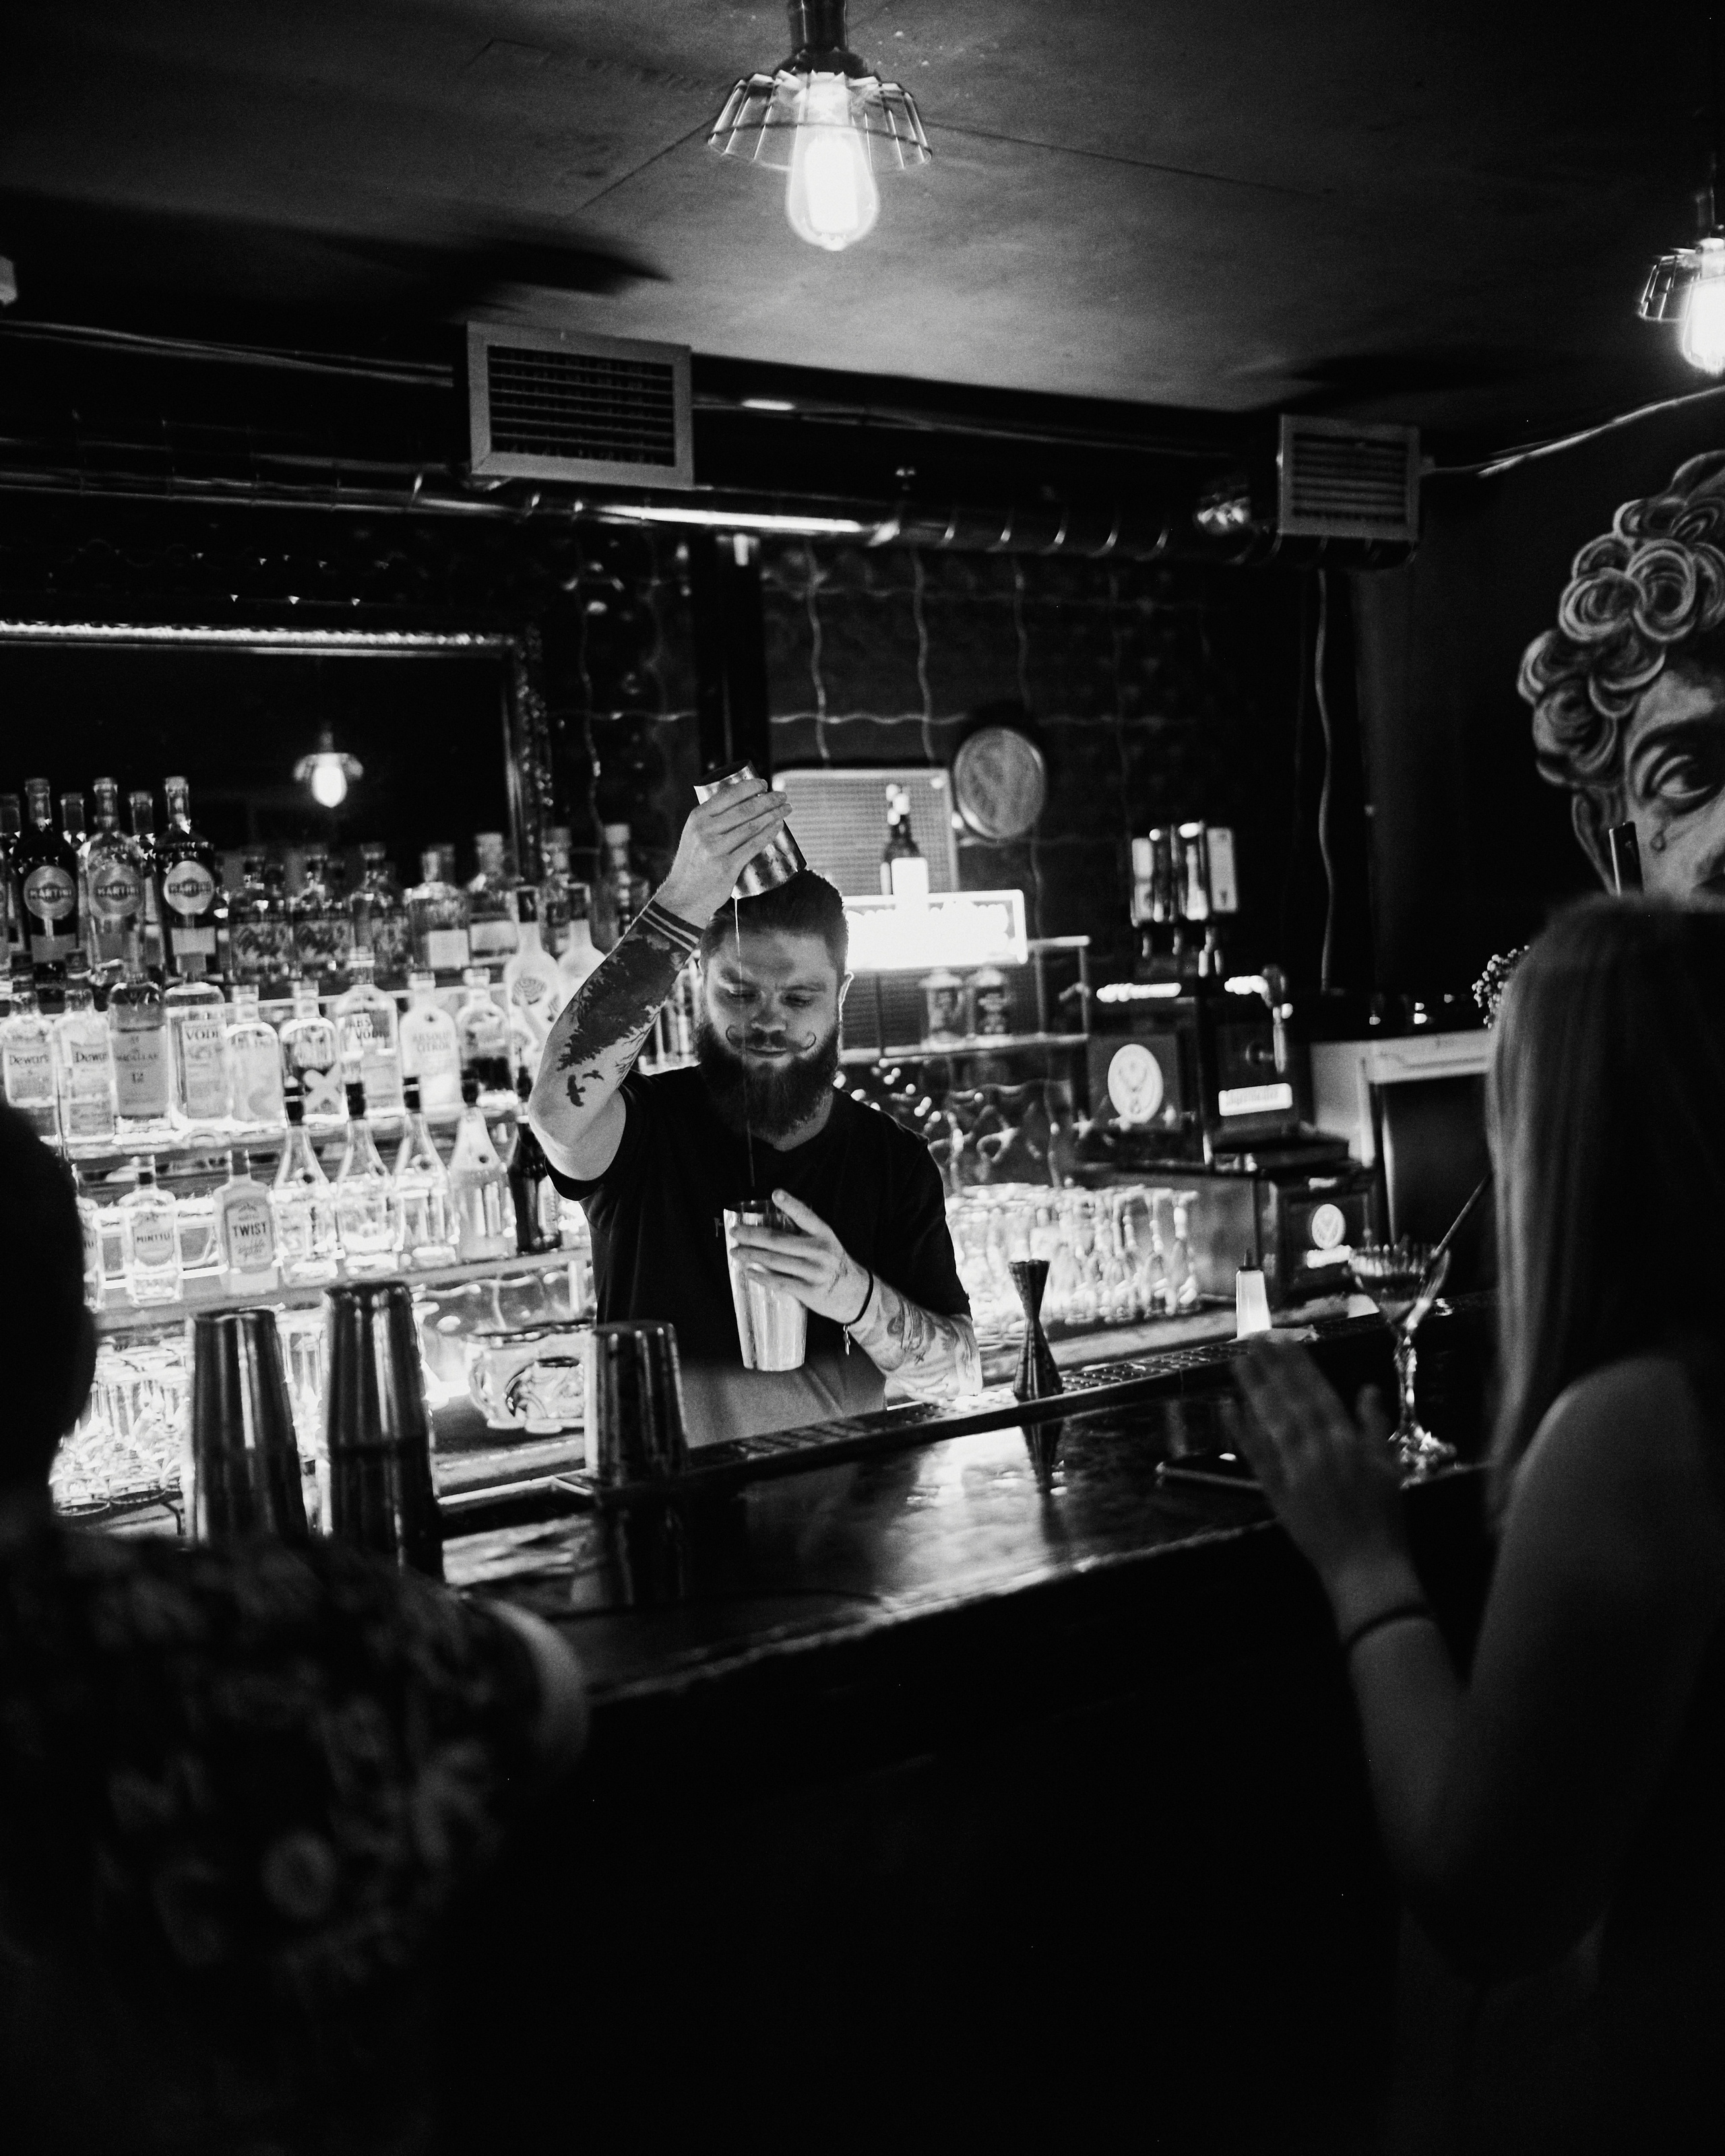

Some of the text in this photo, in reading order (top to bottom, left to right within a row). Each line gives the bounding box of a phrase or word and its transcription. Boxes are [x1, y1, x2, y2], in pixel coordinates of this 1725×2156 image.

[29, 888, 72, 899] MARTINI
[231, 1221, 266, 1237] TWIST
[136, 1232, 170, 1244] MINTTU
